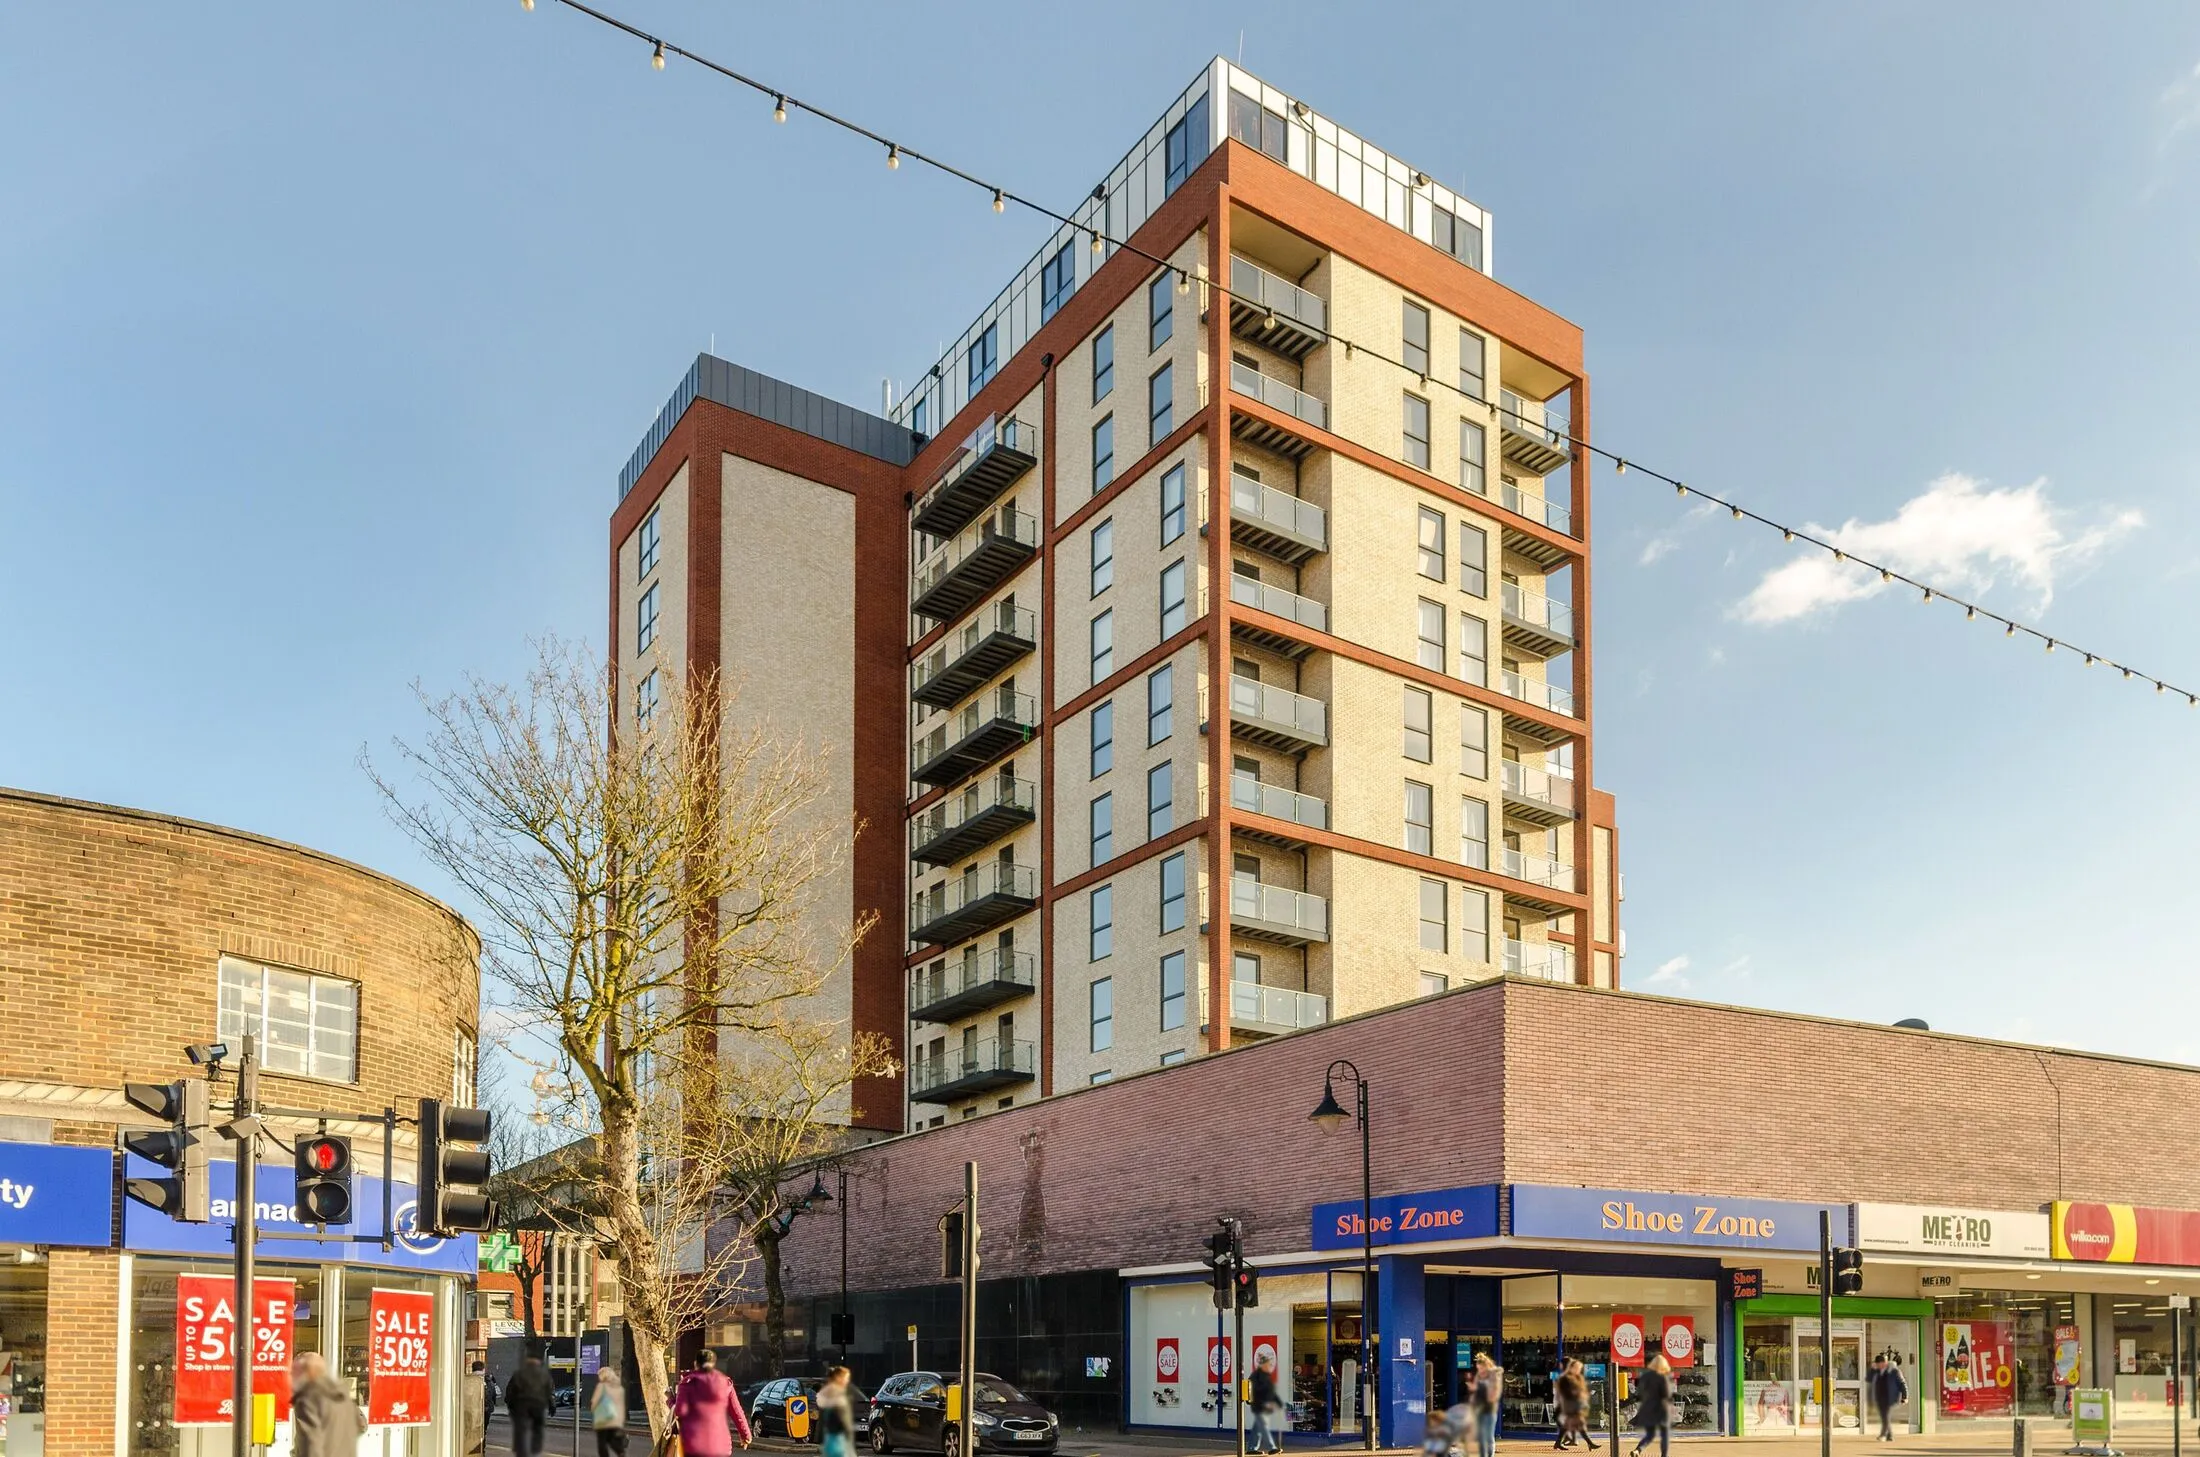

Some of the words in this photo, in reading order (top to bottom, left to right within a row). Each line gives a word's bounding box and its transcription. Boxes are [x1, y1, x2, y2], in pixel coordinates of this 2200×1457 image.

[1336, 1214, 1393, 1236] Shoe
[1399, 1207, 1464, 1231] Zone
[1601, 1201, 1684, 1233] Shoe
[1693, 1206, 1776, 1238] Zone
[1922, 1215, 1992, 1243] METRO
[1949, 1241, 1980, 1249] CLEANING
[1734, 1272, 1757, 1285] Shoe
[1922, 1275, 1952, 1286] METRO
[1734, 1285, 1757, 1298] Zone
[185, 1297, 286, 1324] SAE
[375, 1309, 429, 1335] SALE
[185, 1325, 197, 1342] TO
[374, 1335, 382, 1350] TO
[1616, 1337, 1641, 1349] SALE
[1667, 1338, 1690, 1350] SALE
[185, 1345, 197, 1361] UP
[256, 1352, 286, 1362] OFF
[382, 1336, 429, 1368] 50%
[374, 1354, 382, 1367] UP
[412, 1360, 428, 1369] OFF
[1160, 1358, 1177, 1368] SALE
[185, 1363, 204, 1372] Shop
[205, 1363, 211, 1371] in
